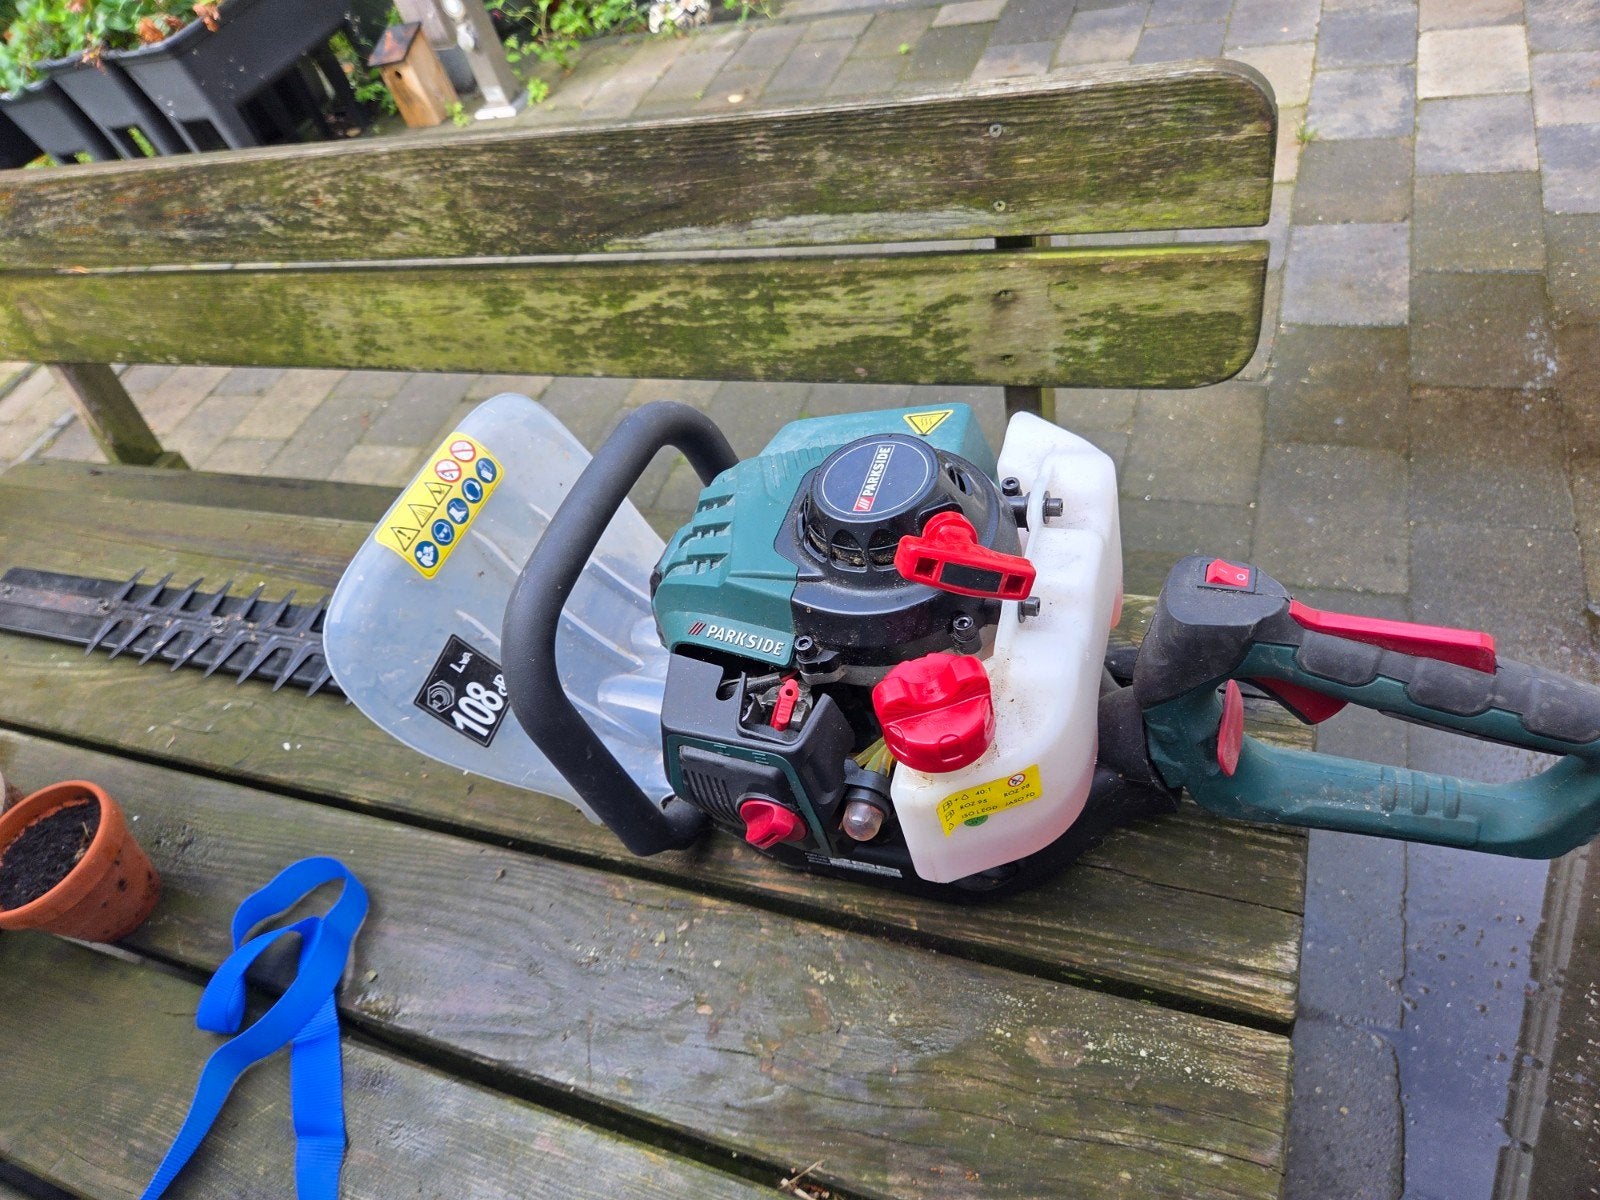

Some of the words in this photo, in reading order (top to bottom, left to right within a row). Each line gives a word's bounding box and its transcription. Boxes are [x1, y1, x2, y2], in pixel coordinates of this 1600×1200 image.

[862, 446, 892, 497] PARKSIDE
[706, 624, 785, 657] PARKSIDE
[451, 681, 504, 737] 108
[959, 801, 976, 811] ROZ
[1003, 788, 1019, 798] ROZ
